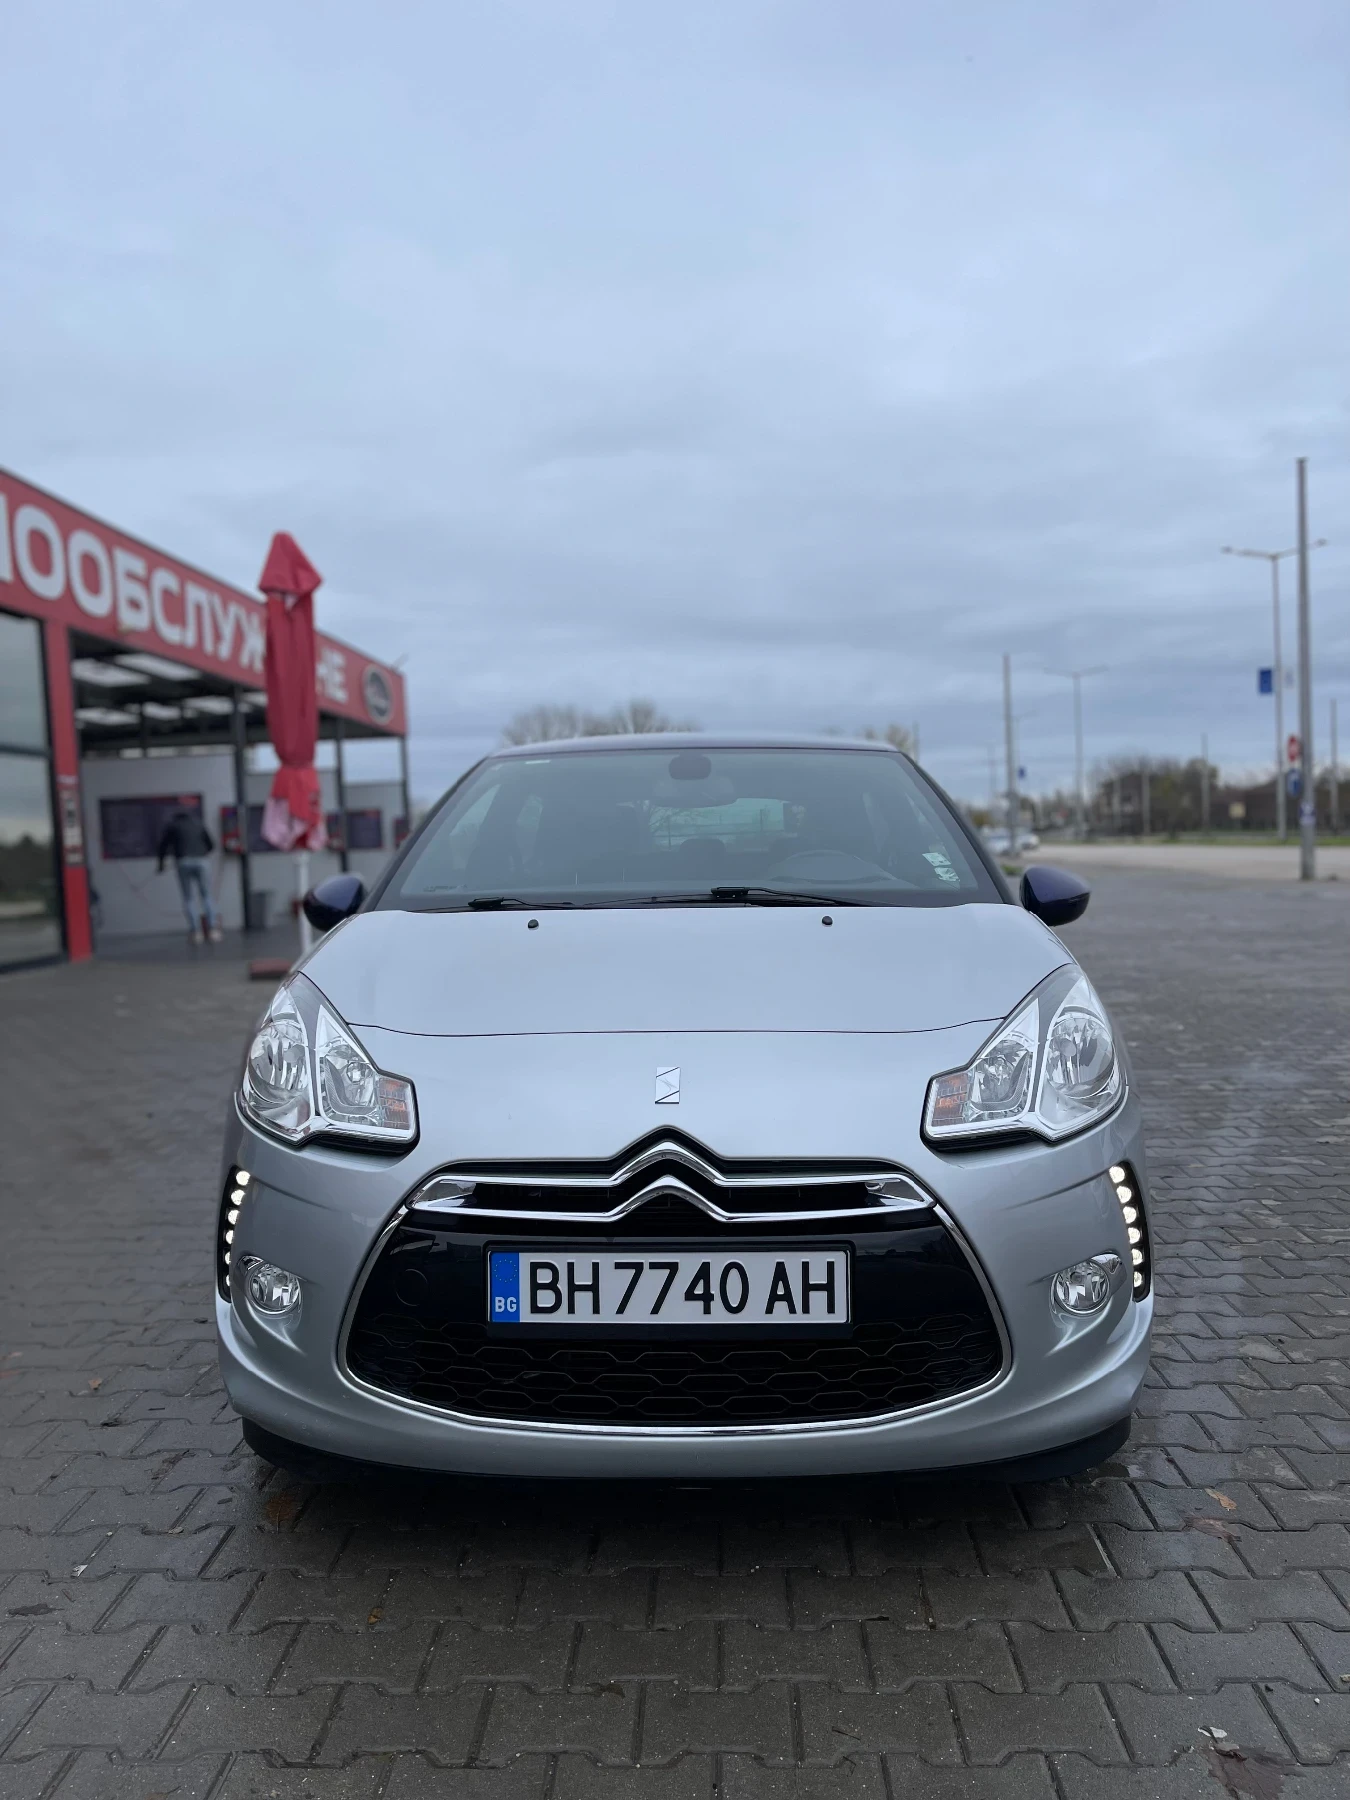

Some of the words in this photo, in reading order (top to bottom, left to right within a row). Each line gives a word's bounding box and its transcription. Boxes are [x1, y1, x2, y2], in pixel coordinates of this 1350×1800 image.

[495, 1296, 517, 1313] BG
[530, 1261, 600, 1314] BH
[614, 1261, 749, 1315] 7740
[765, 1260, 836, 1315] AH
